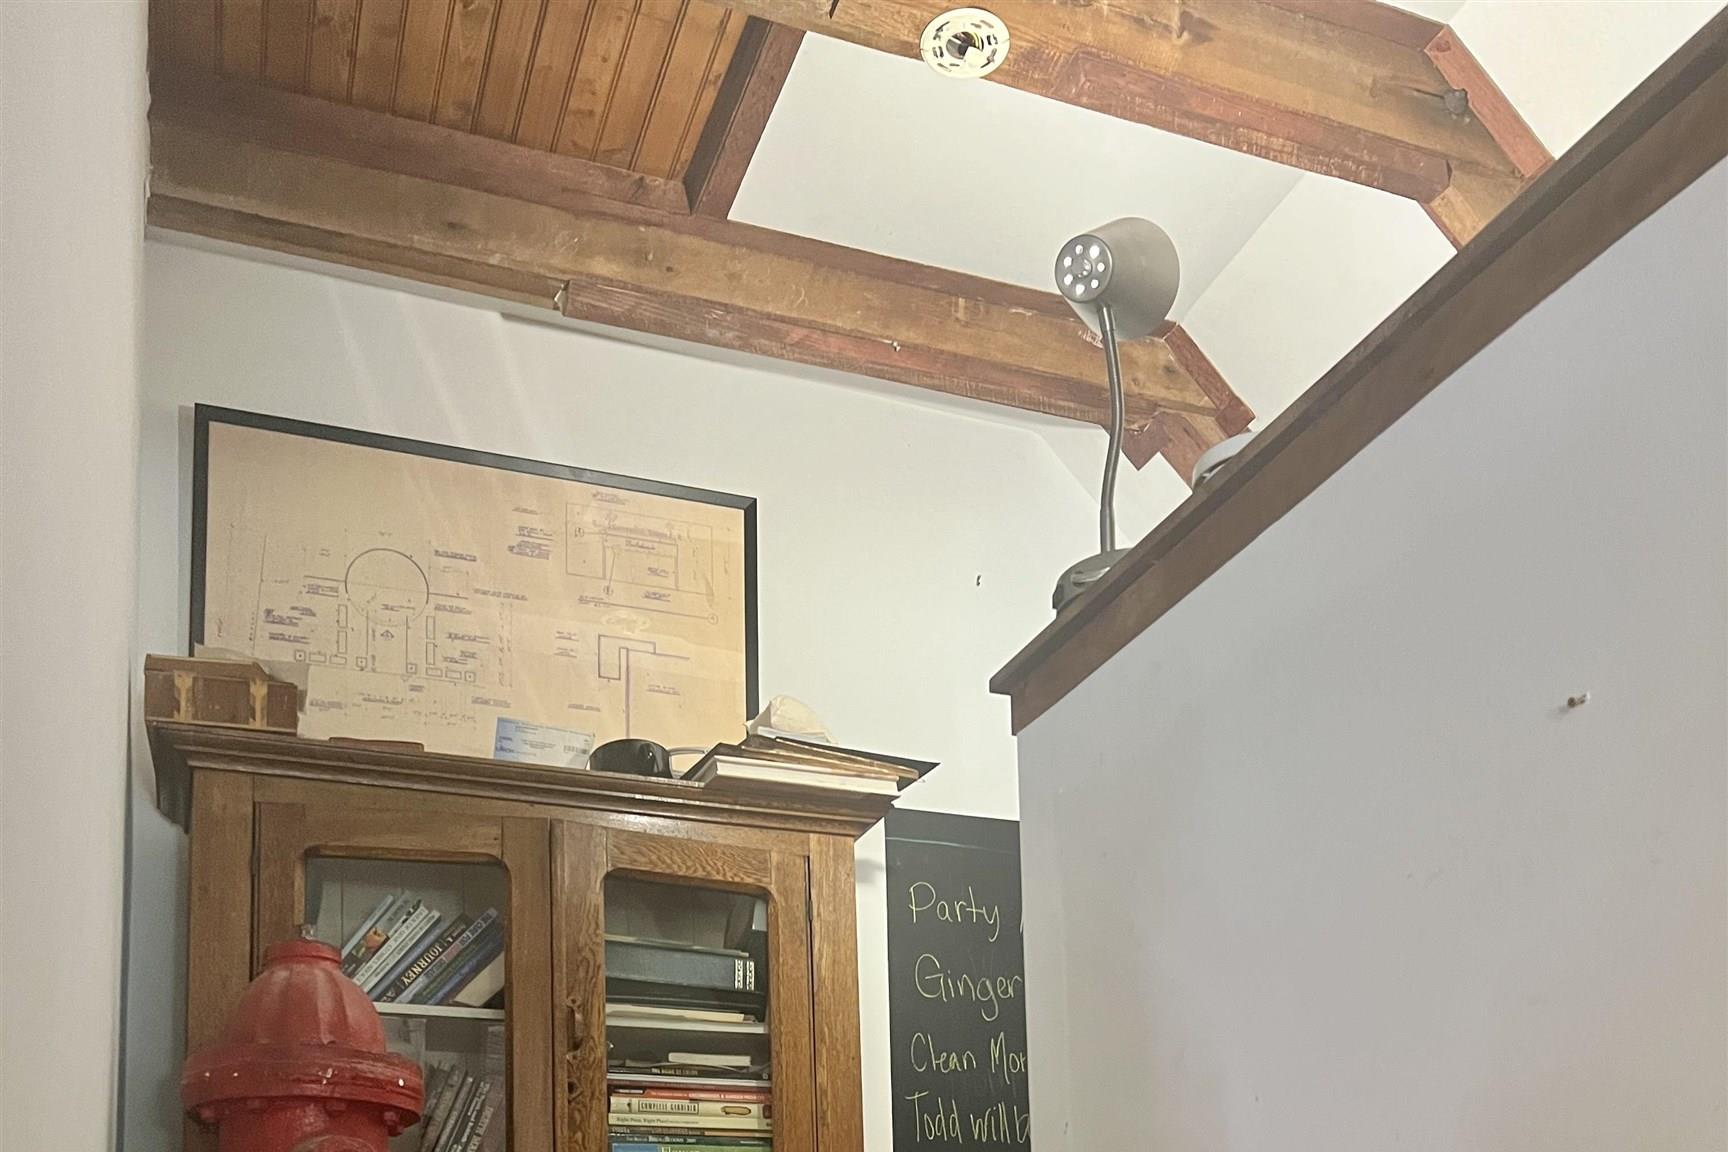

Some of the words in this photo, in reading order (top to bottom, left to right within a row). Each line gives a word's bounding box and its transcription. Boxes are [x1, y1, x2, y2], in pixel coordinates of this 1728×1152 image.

[909, 881, 1001, 943] Party
[401, 943, 443, 987] JOURNEY
[914, 953, 1023, 1022] Ginger
[910, 1032, 977, 1074] Clean
[905, 1090, 963, 1144] Todd
[969, 1101, 1011, 1144] will
